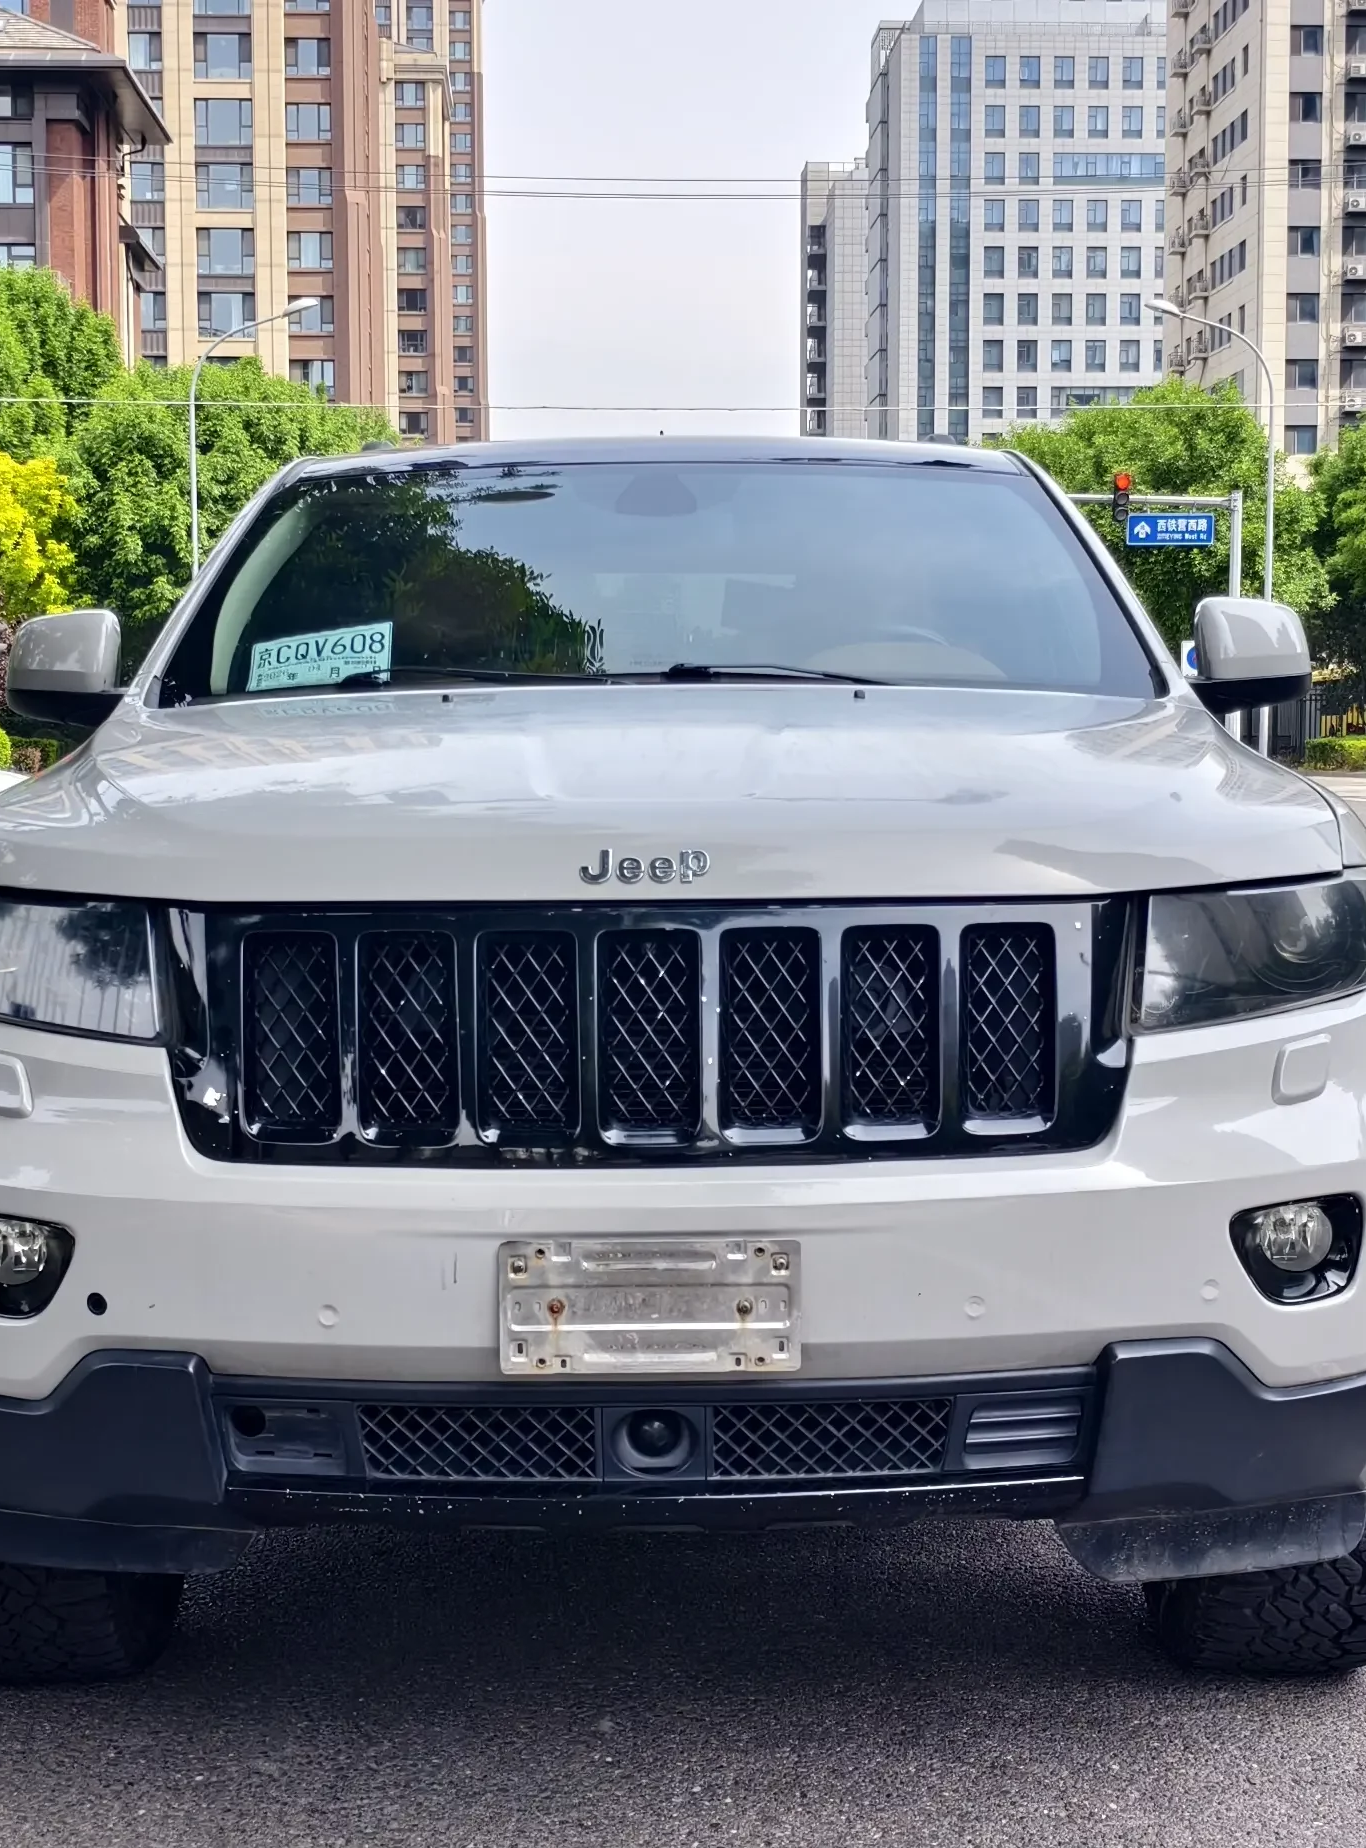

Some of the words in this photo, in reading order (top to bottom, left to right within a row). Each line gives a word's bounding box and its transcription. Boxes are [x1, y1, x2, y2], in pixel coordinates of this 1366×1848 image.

[1156, 518, 1208, 531] 西铁营西路
[257, 631, 386, 669] 京CQV608
[579, 848, 711, 885] Jeep
